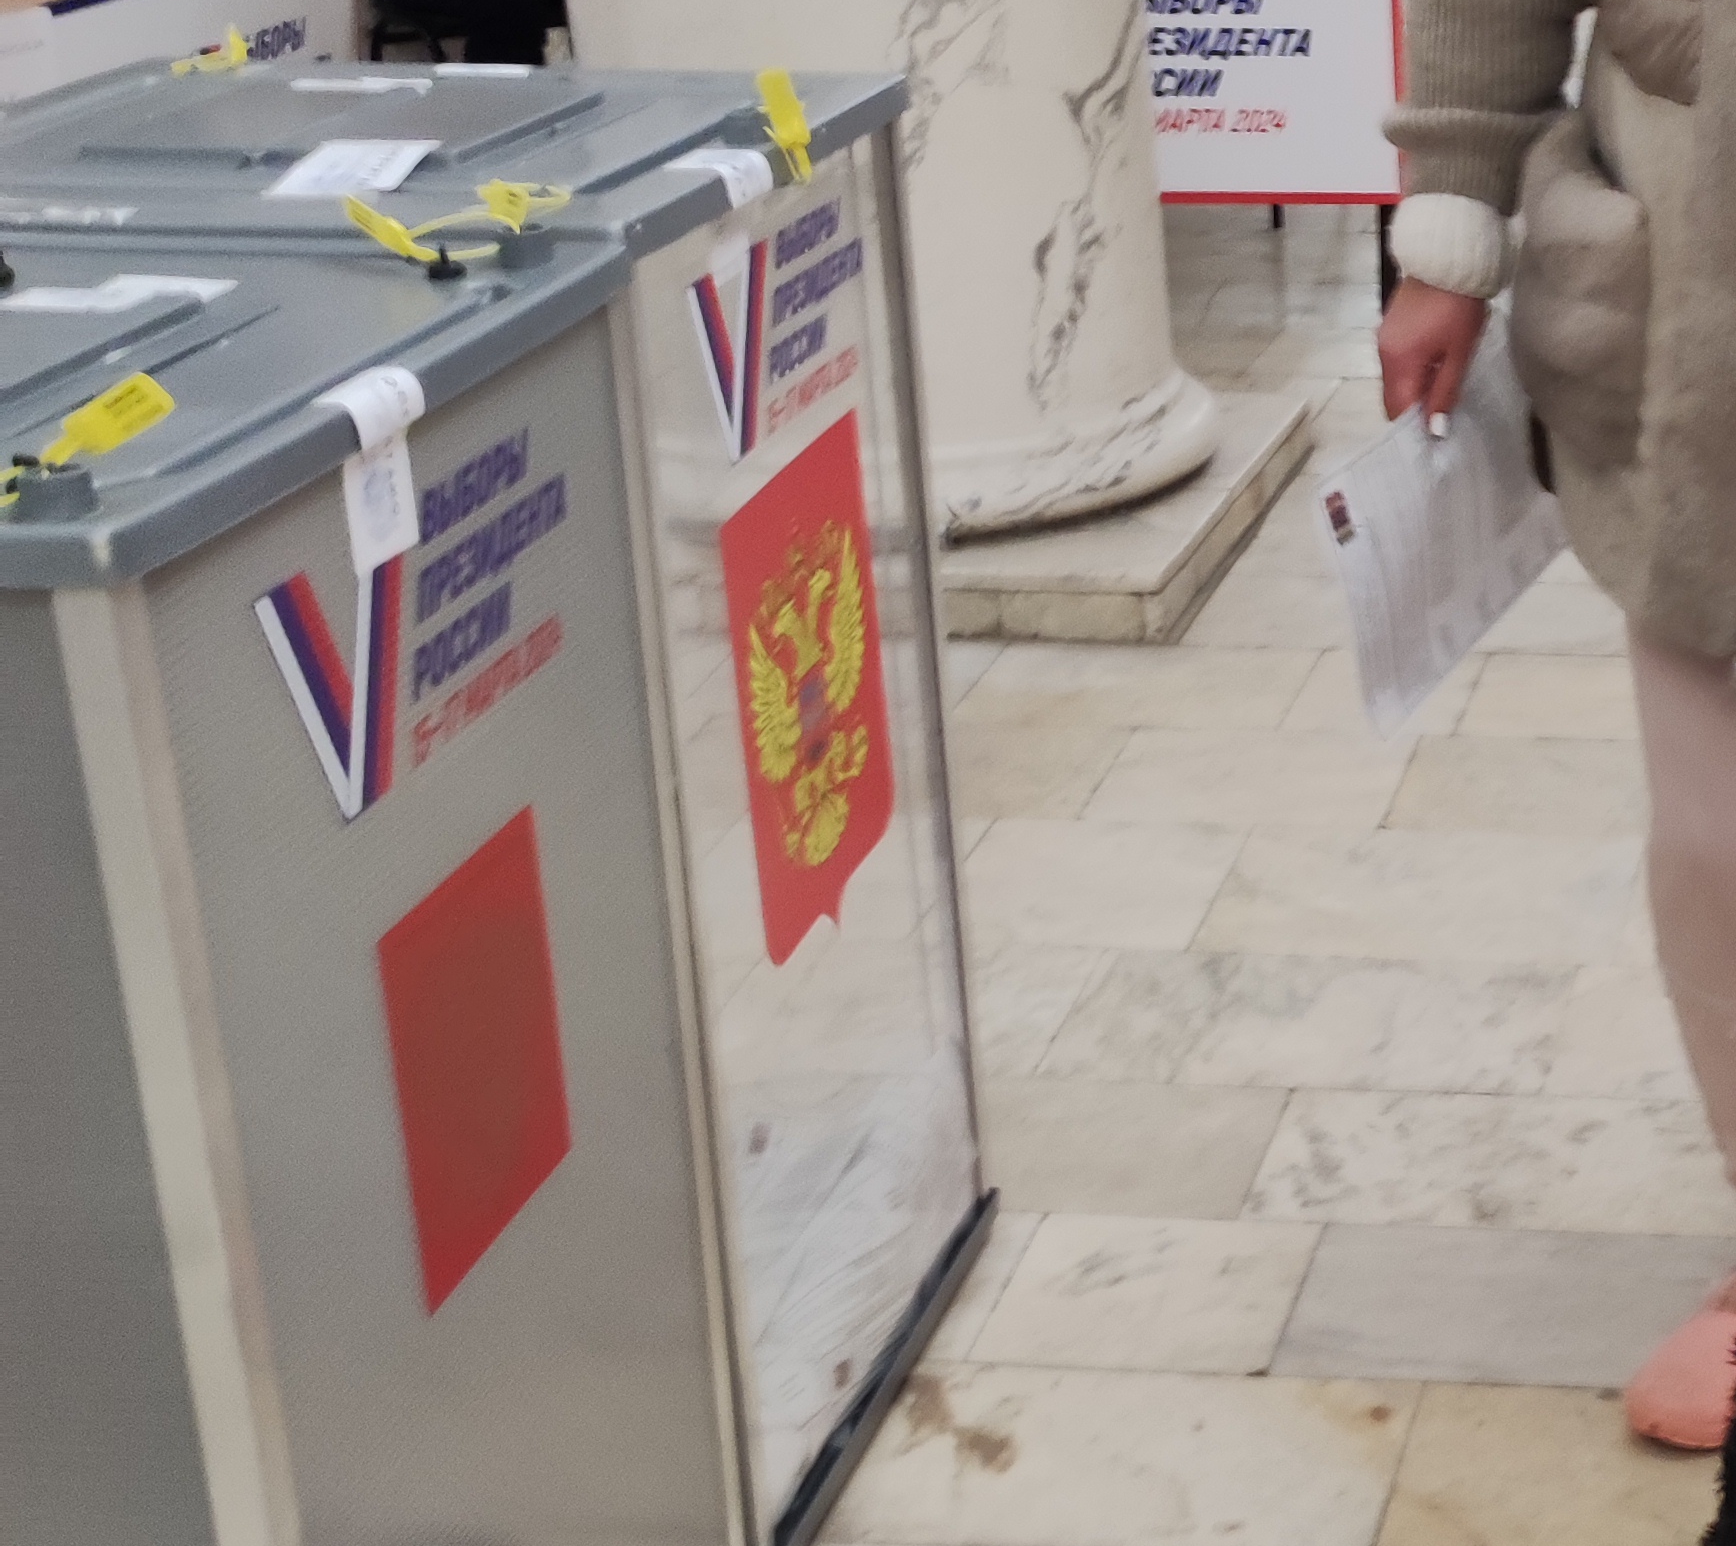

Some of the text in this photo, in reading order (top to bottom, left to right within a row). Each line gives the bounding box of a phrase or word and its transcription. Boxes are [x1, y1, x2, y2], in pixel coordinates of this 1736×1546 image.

[244, 16, 308, 61] ЫБОРЫ
[1146, 26, 1314, 62] ЕЗИДЕНТА
[419, 427, 530, 546] ВЫБОРЫ
[416, 472, 569, 624] ПРЕЗИДЕНТА
[411, 581, 513, 705] РОССИИ
